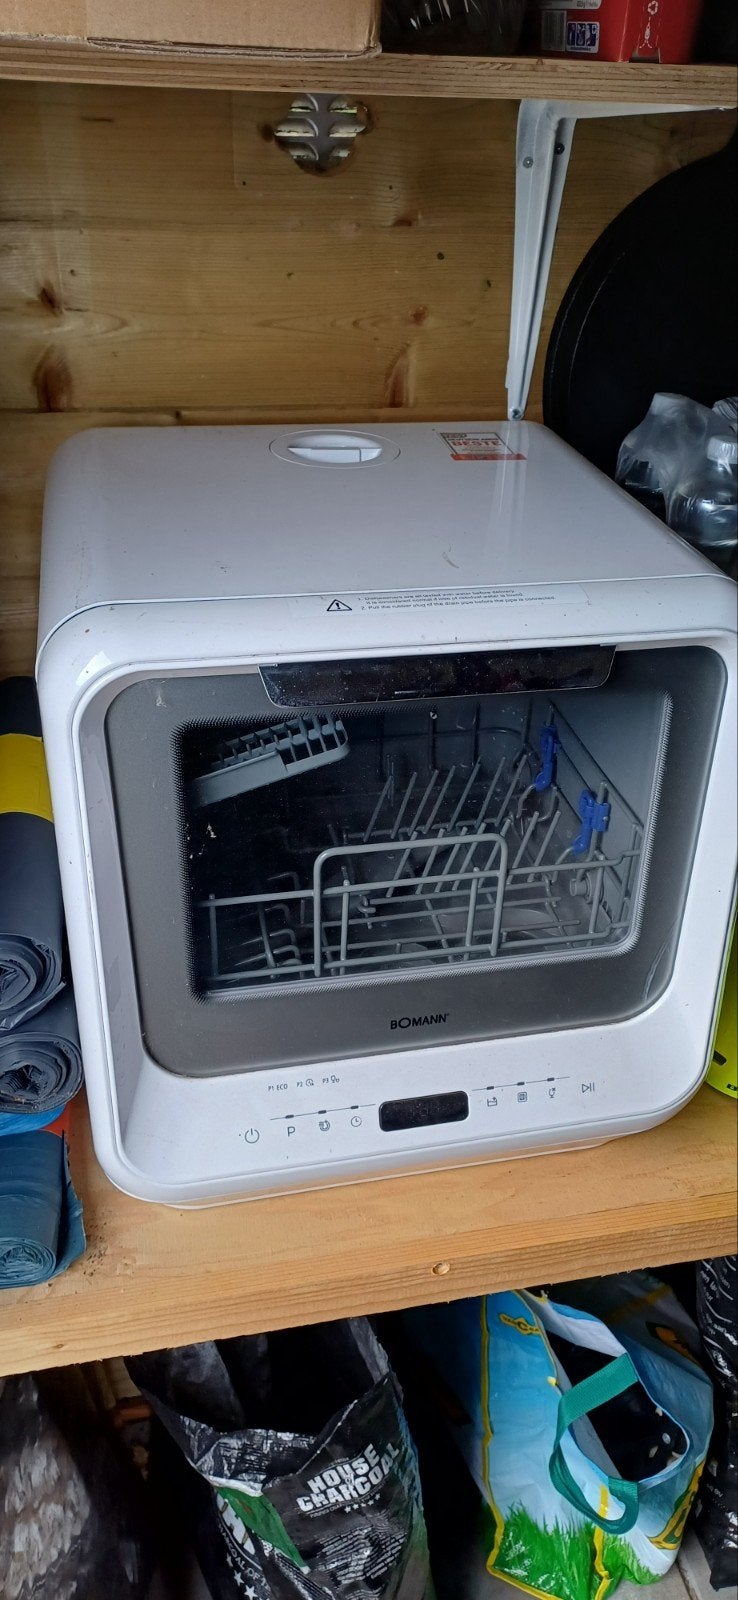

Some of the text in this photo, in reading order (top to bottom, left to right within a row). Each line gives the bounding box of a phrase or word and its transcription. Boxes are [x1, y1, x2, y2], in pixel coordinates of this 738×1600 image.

[276, 1083, 288, 1091] ECO
[296, 1442, 401, 1513] CHARCOAL
[306, 1442, 381, 1495] HOUSE
